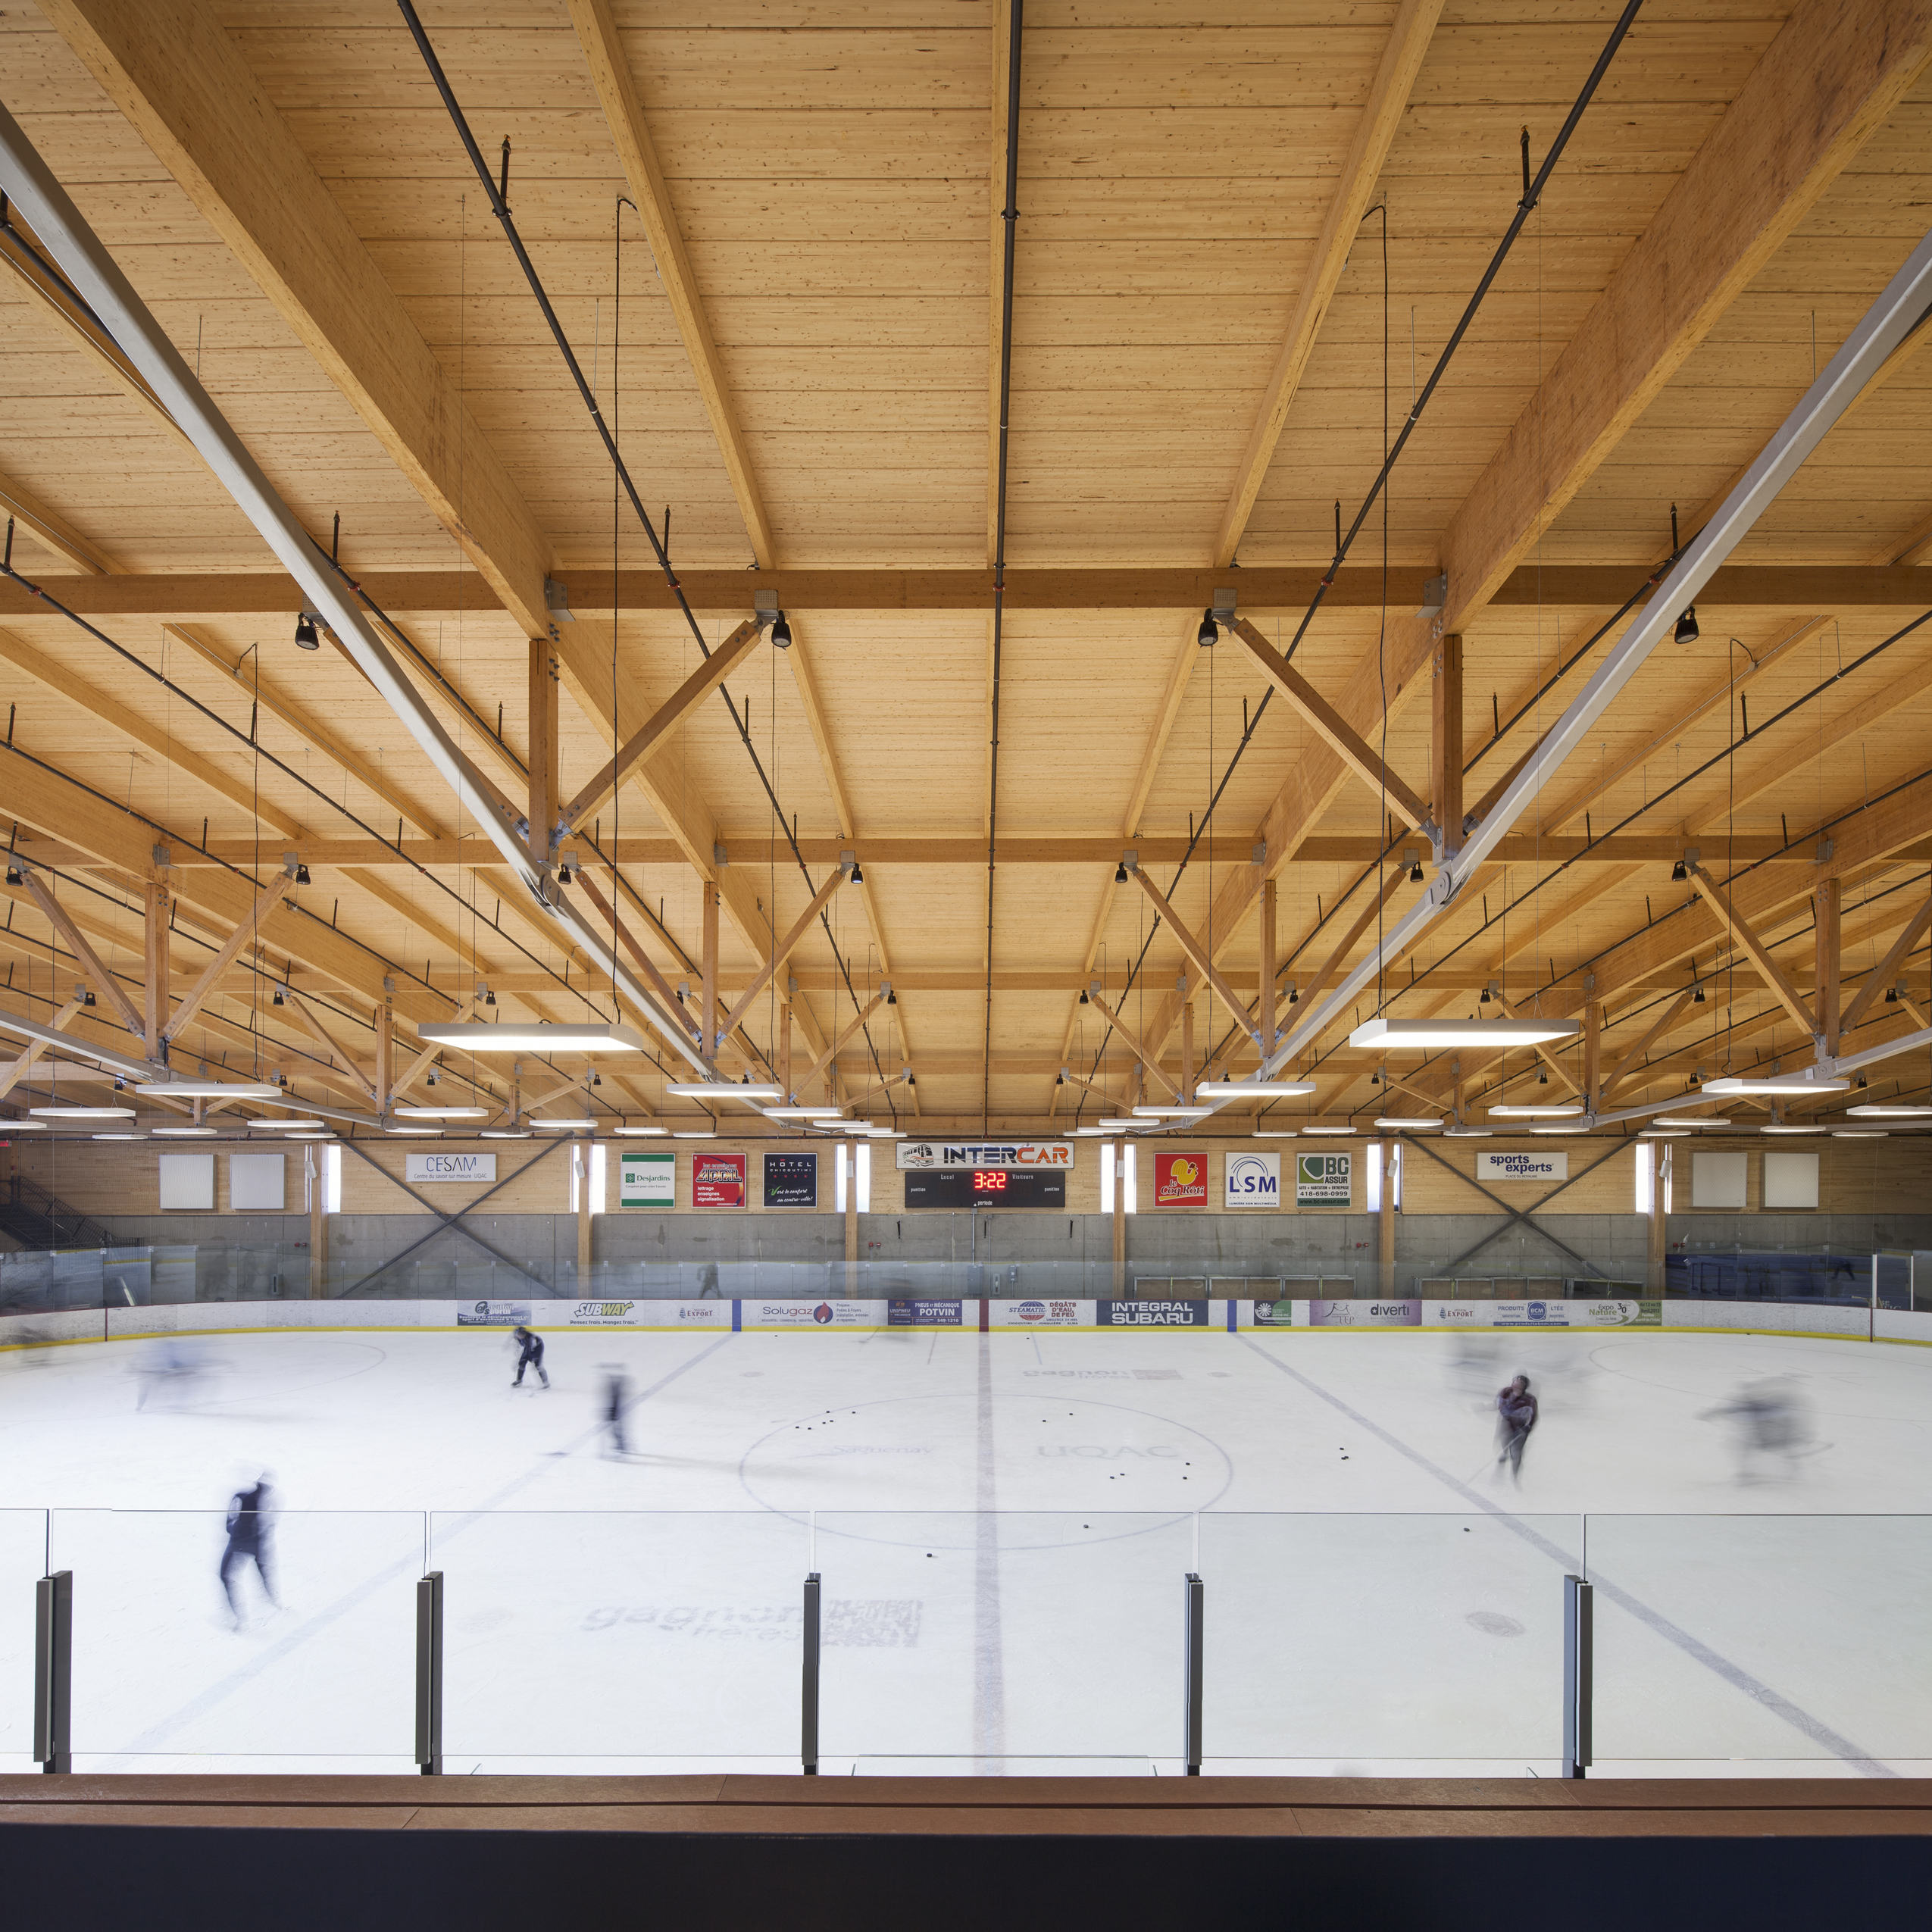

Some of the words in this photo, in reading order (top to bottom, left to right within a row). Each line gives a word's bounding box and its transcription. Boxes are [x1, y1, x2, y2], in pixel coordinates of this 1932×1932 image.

[944, 1147, 1069, 1164] INTERCAR
[1490, 1155, 1529, 1166] sports
[426, 1156, 477, 1171] CESAM
[1326, 1157, 1349, 1175] BC
[1505, 1163, 1552, 1174] experts
[974, 1173, 1006, 1188] 3:22
[1229, 1176, 1276, 1193] LSM
[1161, 1186, 1181, 1196] Coq
[1182, 1185, 1205, 1194] Rôti
[574, 1300, 635, 1318] SUBWAY
[762, 1306, 813, 1317] Solugaz
[920, 1308, 955, 1316] POTVIN
[1112, 1302, 1193, 1311] INTEGRAL
[1370, 1303, 1409, 1315] diverti
[1112, 1312, 1193, 1324] SUBARU
[831, 1445, 936, 1455] Saguenay
[1037, 1446, 1179, 1460] UQAC
